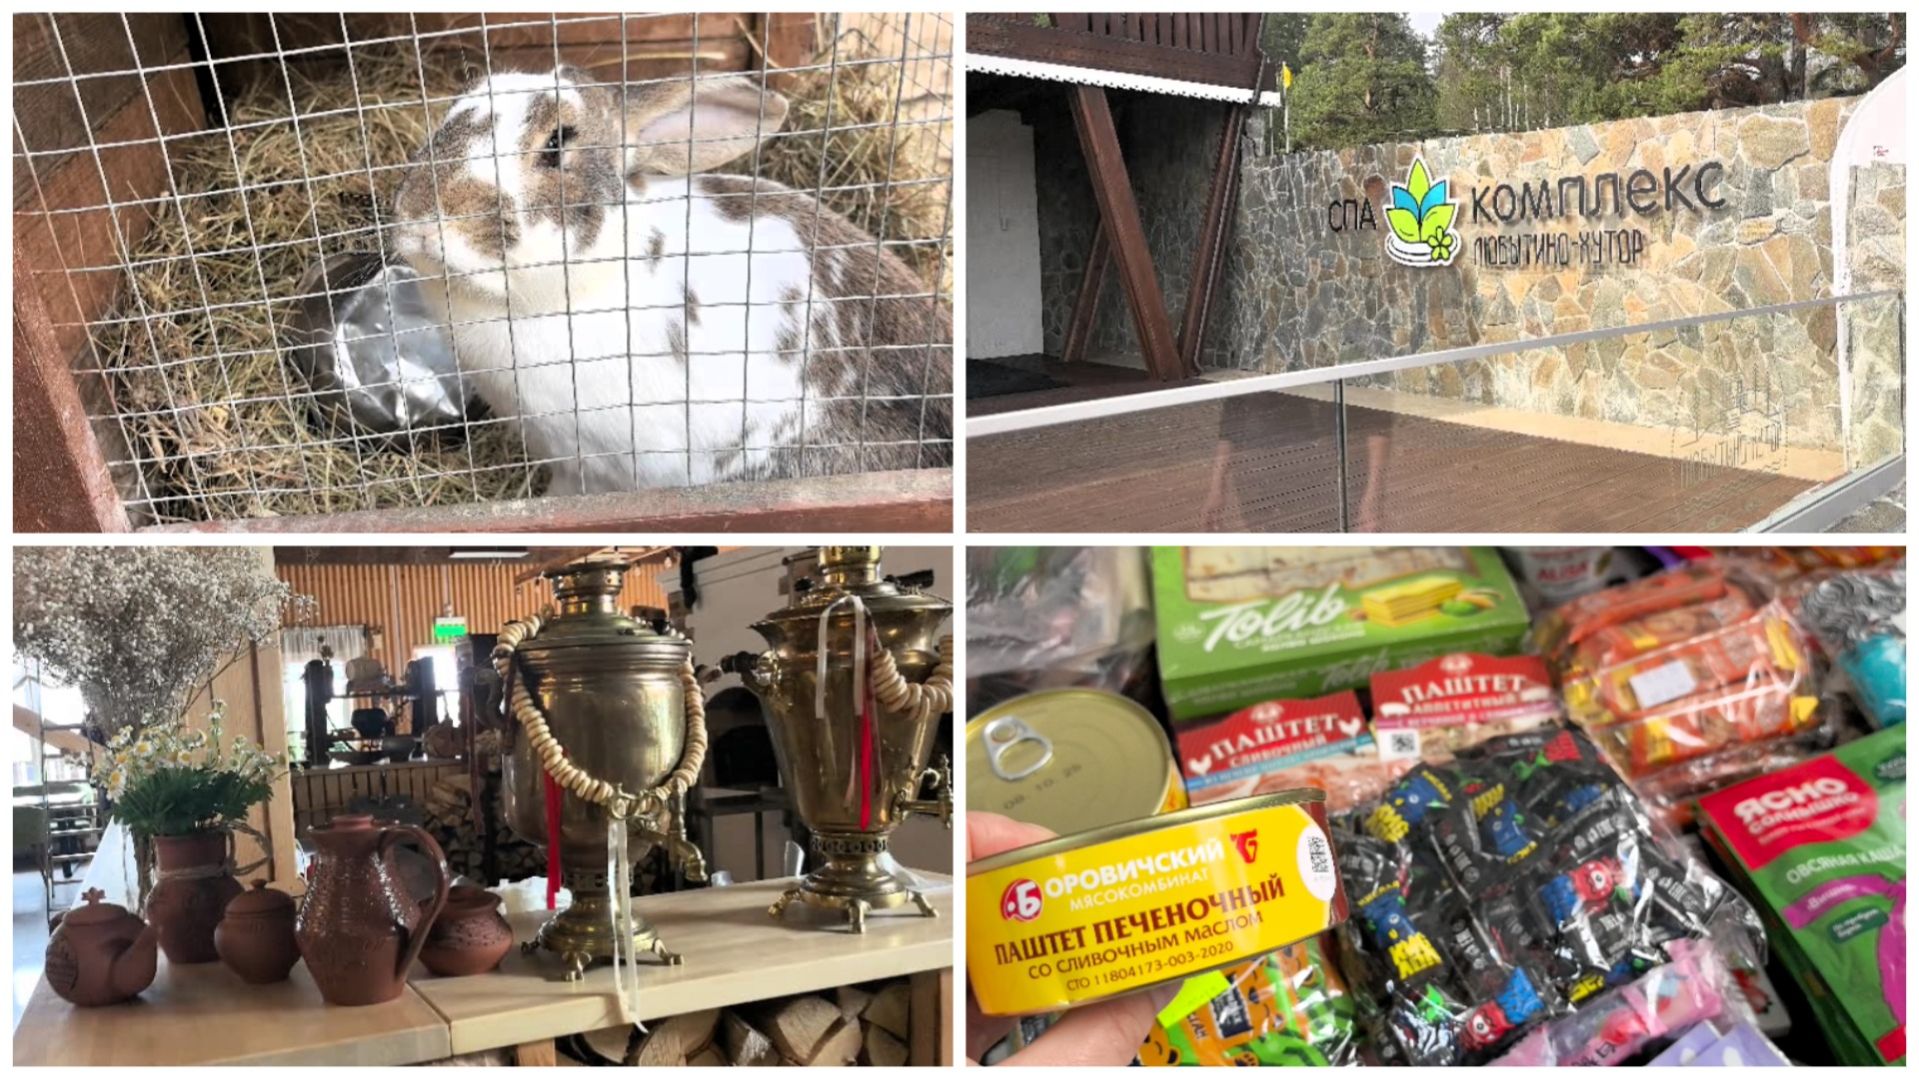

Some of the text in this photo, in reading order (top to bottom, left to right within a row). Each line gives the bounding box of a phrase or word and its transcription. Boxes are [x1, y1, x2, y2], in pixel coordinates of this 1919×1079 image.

[1328, 198, 1377, 232] СПА
[1474, 229, 1646, 266] ЛЮБЫТИНО-ХУТОР
[1199, 582, 1345, 653] Tolib
[1402, 674, 1526, 704] ПАШТЕТ
[1210, 713, 1338, 760] ПАШТЕТ
[1230, 734, 1327, 768] СЛИВОЧНЫЙ
[1734, 777, 1848, 825] ЯСНО
[1749, 792, 1860, 834] СОЛНЫШКО
[1070, 868, 1209, 912] МЯСОКОМБИНАТ
[1786, 853, 1860, 884] ОВСЯНАЯ
[994, 873, 1285, 966] ПАШТЕТ ПЕЧЕНОЧНЫЙ
[1028, 962, 1052, 980] СО
[1056, 934, 1180, 974] СЛИВОЧНЫМ
[1066, 941, 1234, 993] СТО 11804173-003-2020
